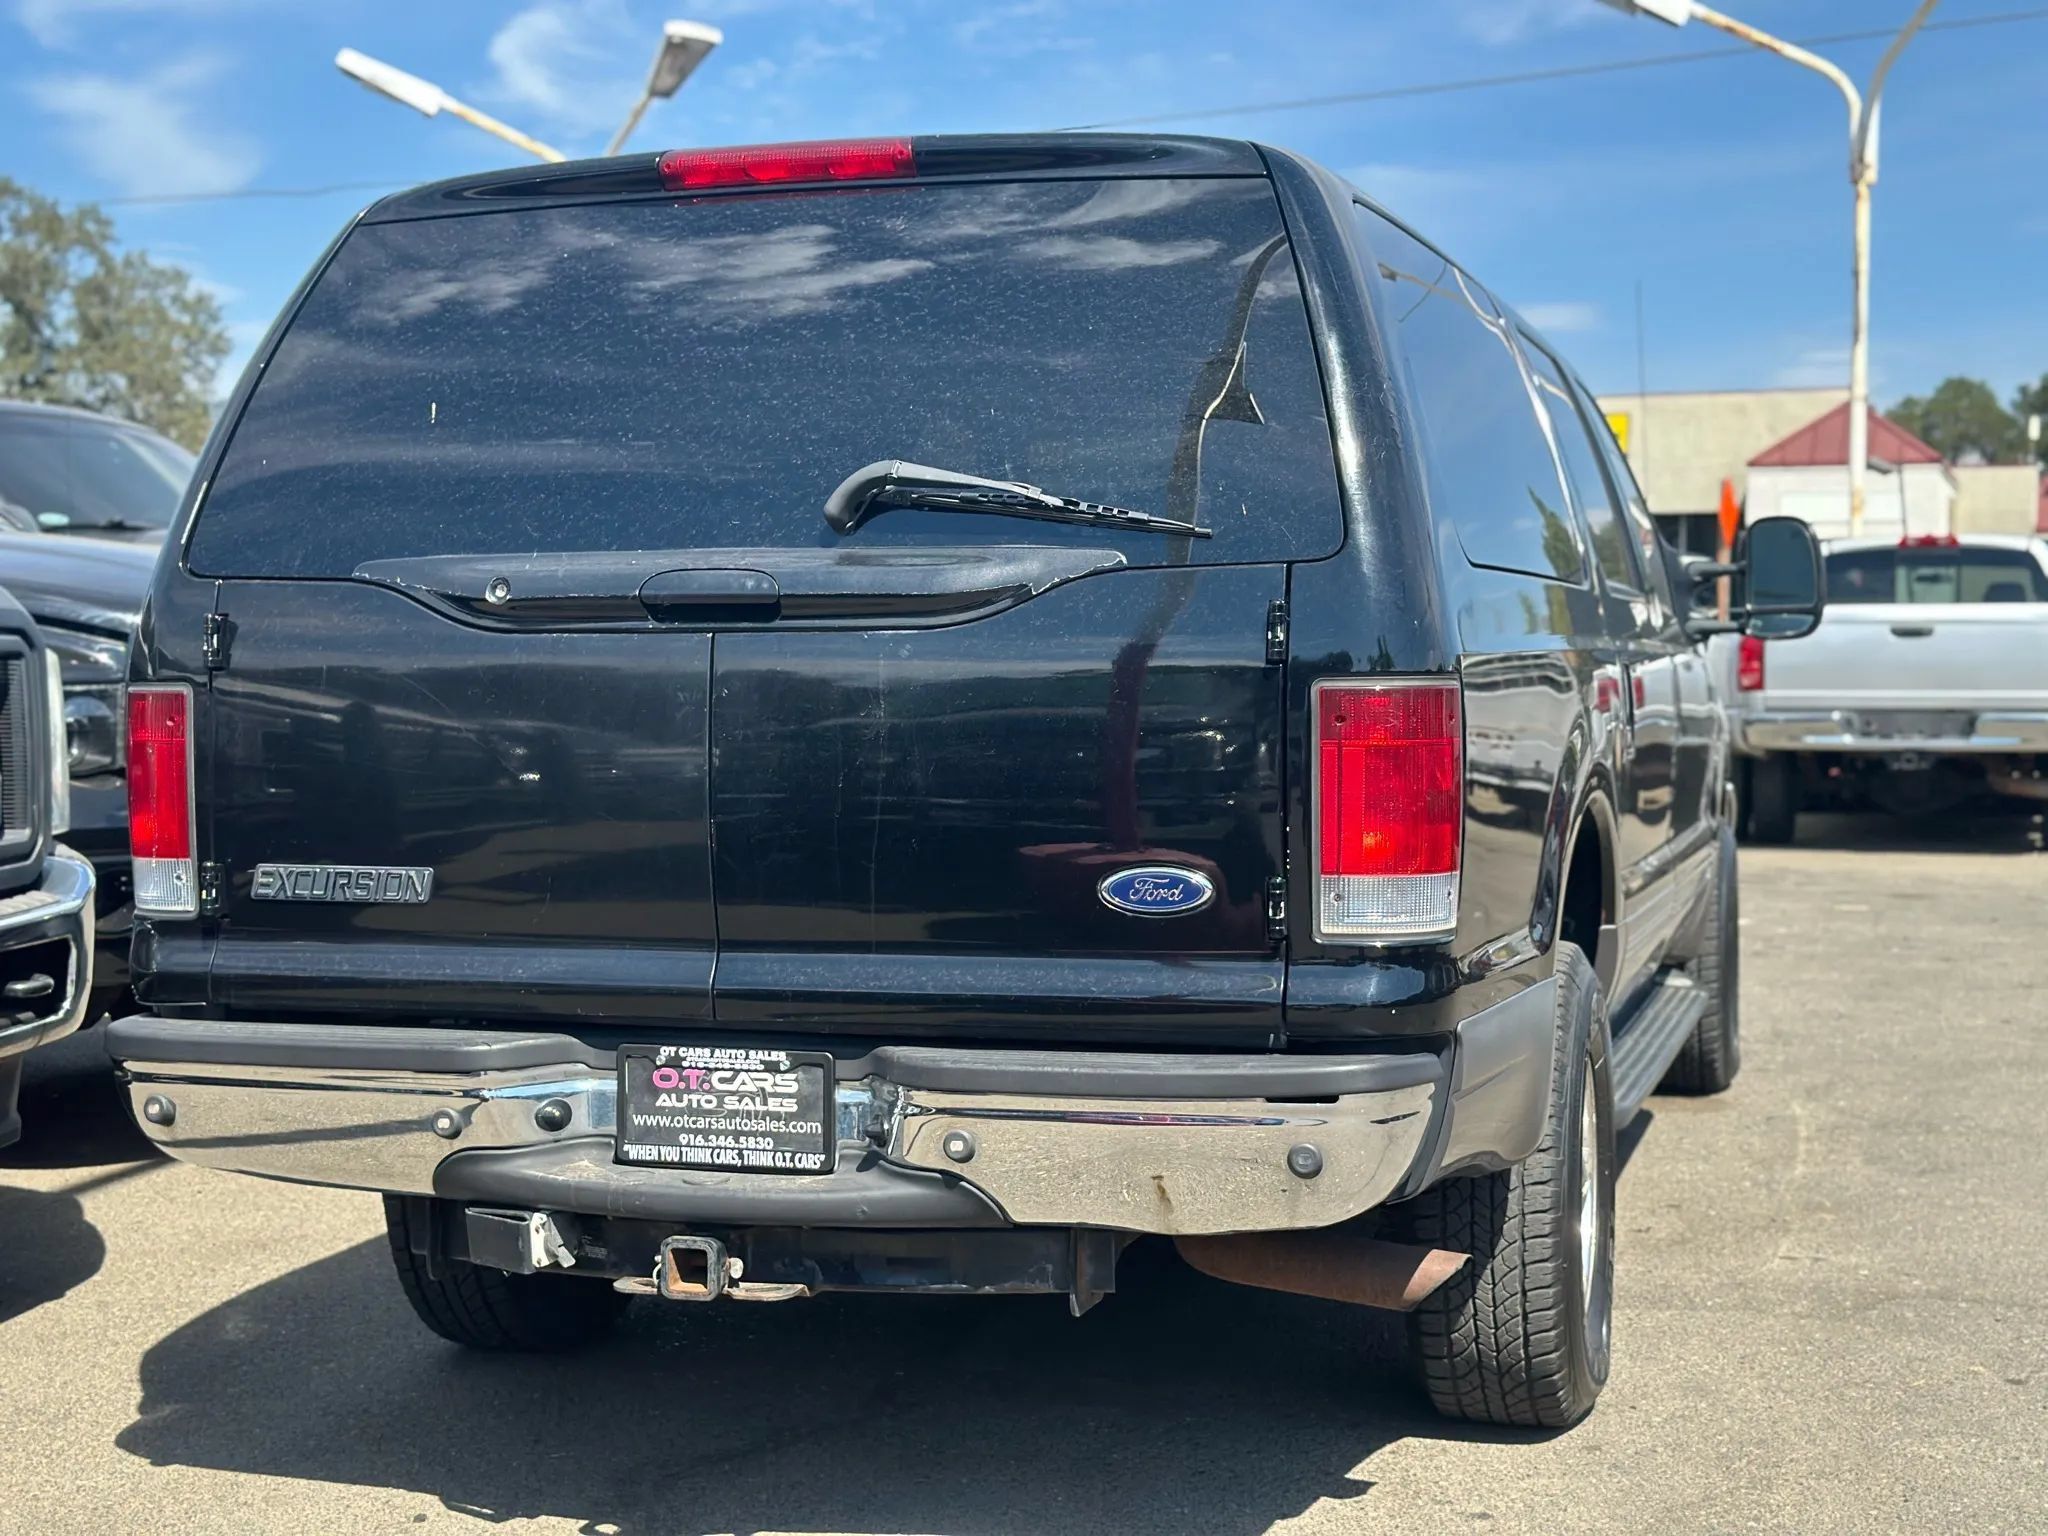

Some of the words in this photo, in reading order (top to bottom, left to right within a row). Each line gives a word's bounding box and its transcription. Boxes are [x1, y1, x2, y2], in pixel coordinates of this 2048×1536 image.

[254, 867, 430, 901] EXCURSION
[1129, 877, 1184, 901] Ford
[660, 1046, 677, 1056] OT
[679, 1047, 711, 1058] CARS
[713, 1049, 746, 1059] AUTO
[748, 1050, 787, 1061] SALES
[655, 1093, 717, 1108] AUTO
[723, 1096, 798, 1112] SALES
[633, 1113, 822, 1134] www.otcarsautosales.com
[679, 1133, 774, 1149] 916.346.5830
[660, 1145, 679, 1161] YOU
[681, 1146, 712, 1163] THINK
[713, 1148, 742, 1167] CARS,
[743, 1149, 774, 1167] THINK
[774, 1151, 793, 1168] O.T.
